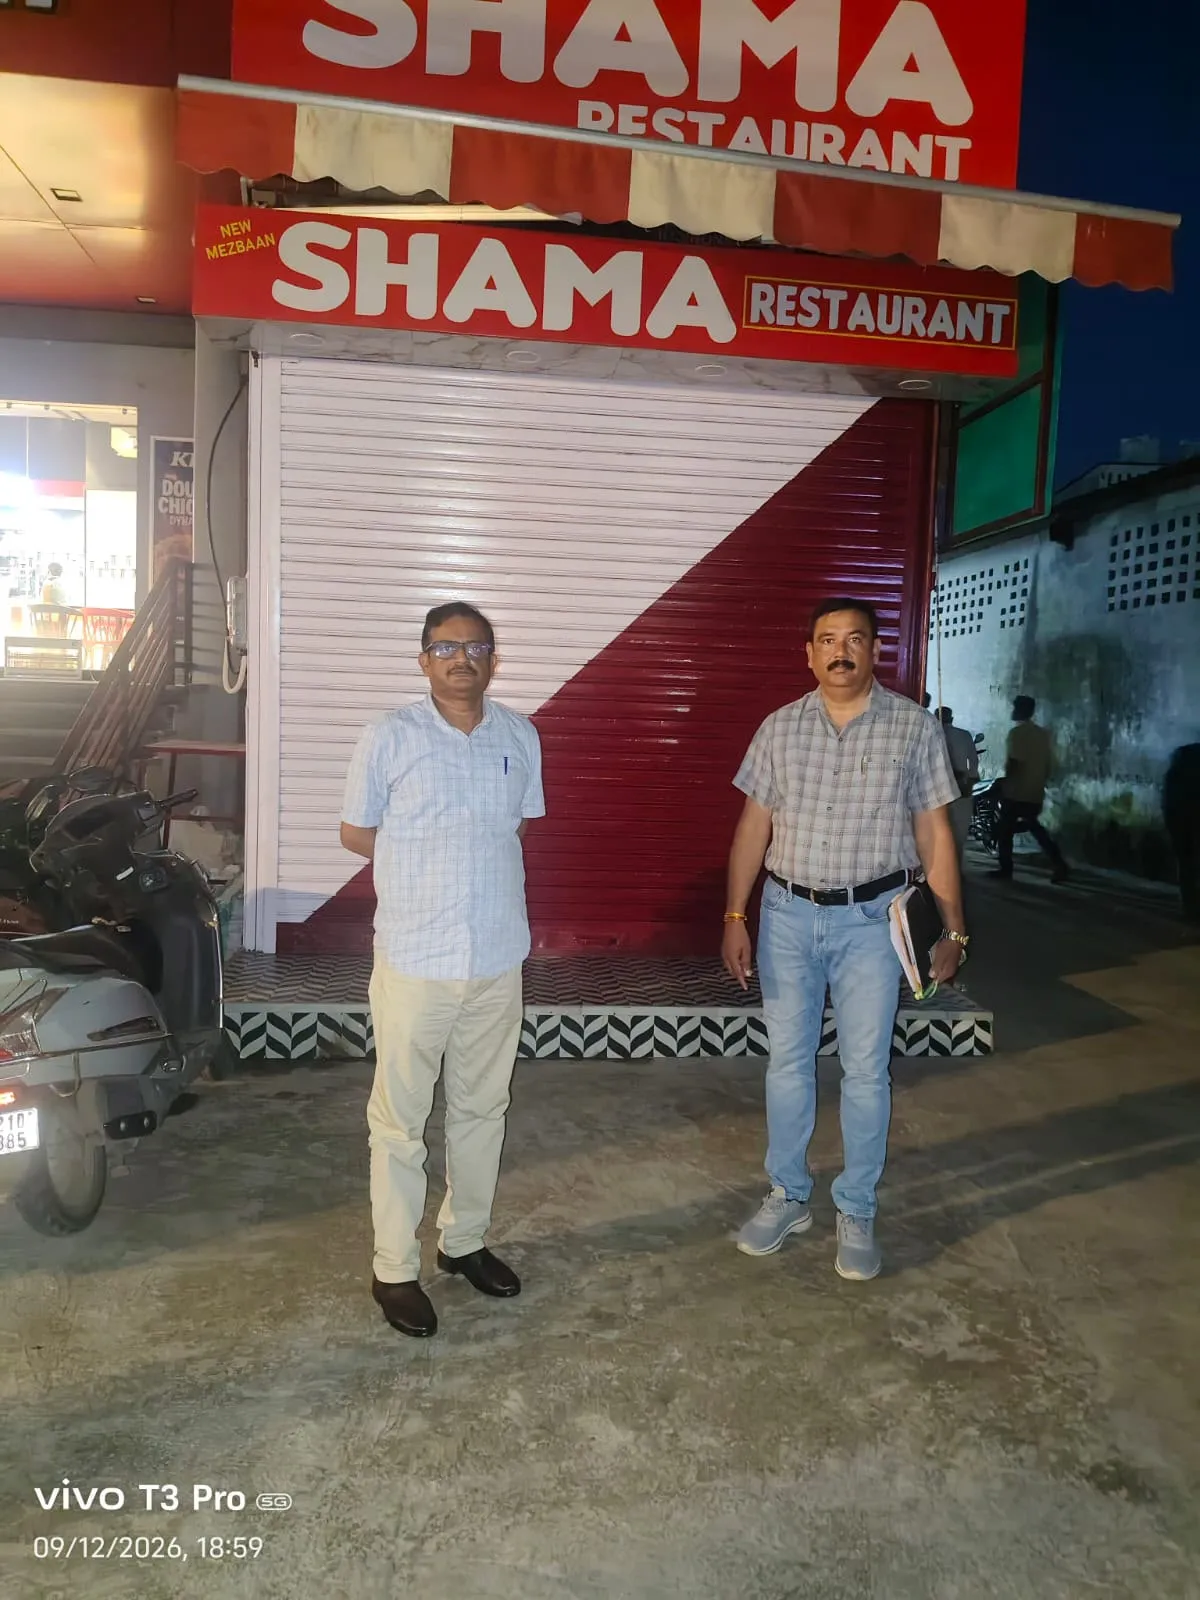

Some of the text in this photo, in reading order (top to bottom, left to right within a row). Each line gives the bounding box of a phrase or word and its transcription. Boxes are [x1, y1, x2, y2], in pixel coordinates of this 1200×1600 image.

[302, 0, 974, 126] SHAMA
[577, 100, 972, 182] RESTAURANT
[205, 233, 276, 261] MEZBAAN
[220, 219, 252, 239] NEW
[272, 221, 1010, 344] SHAMA RESTAURANT
